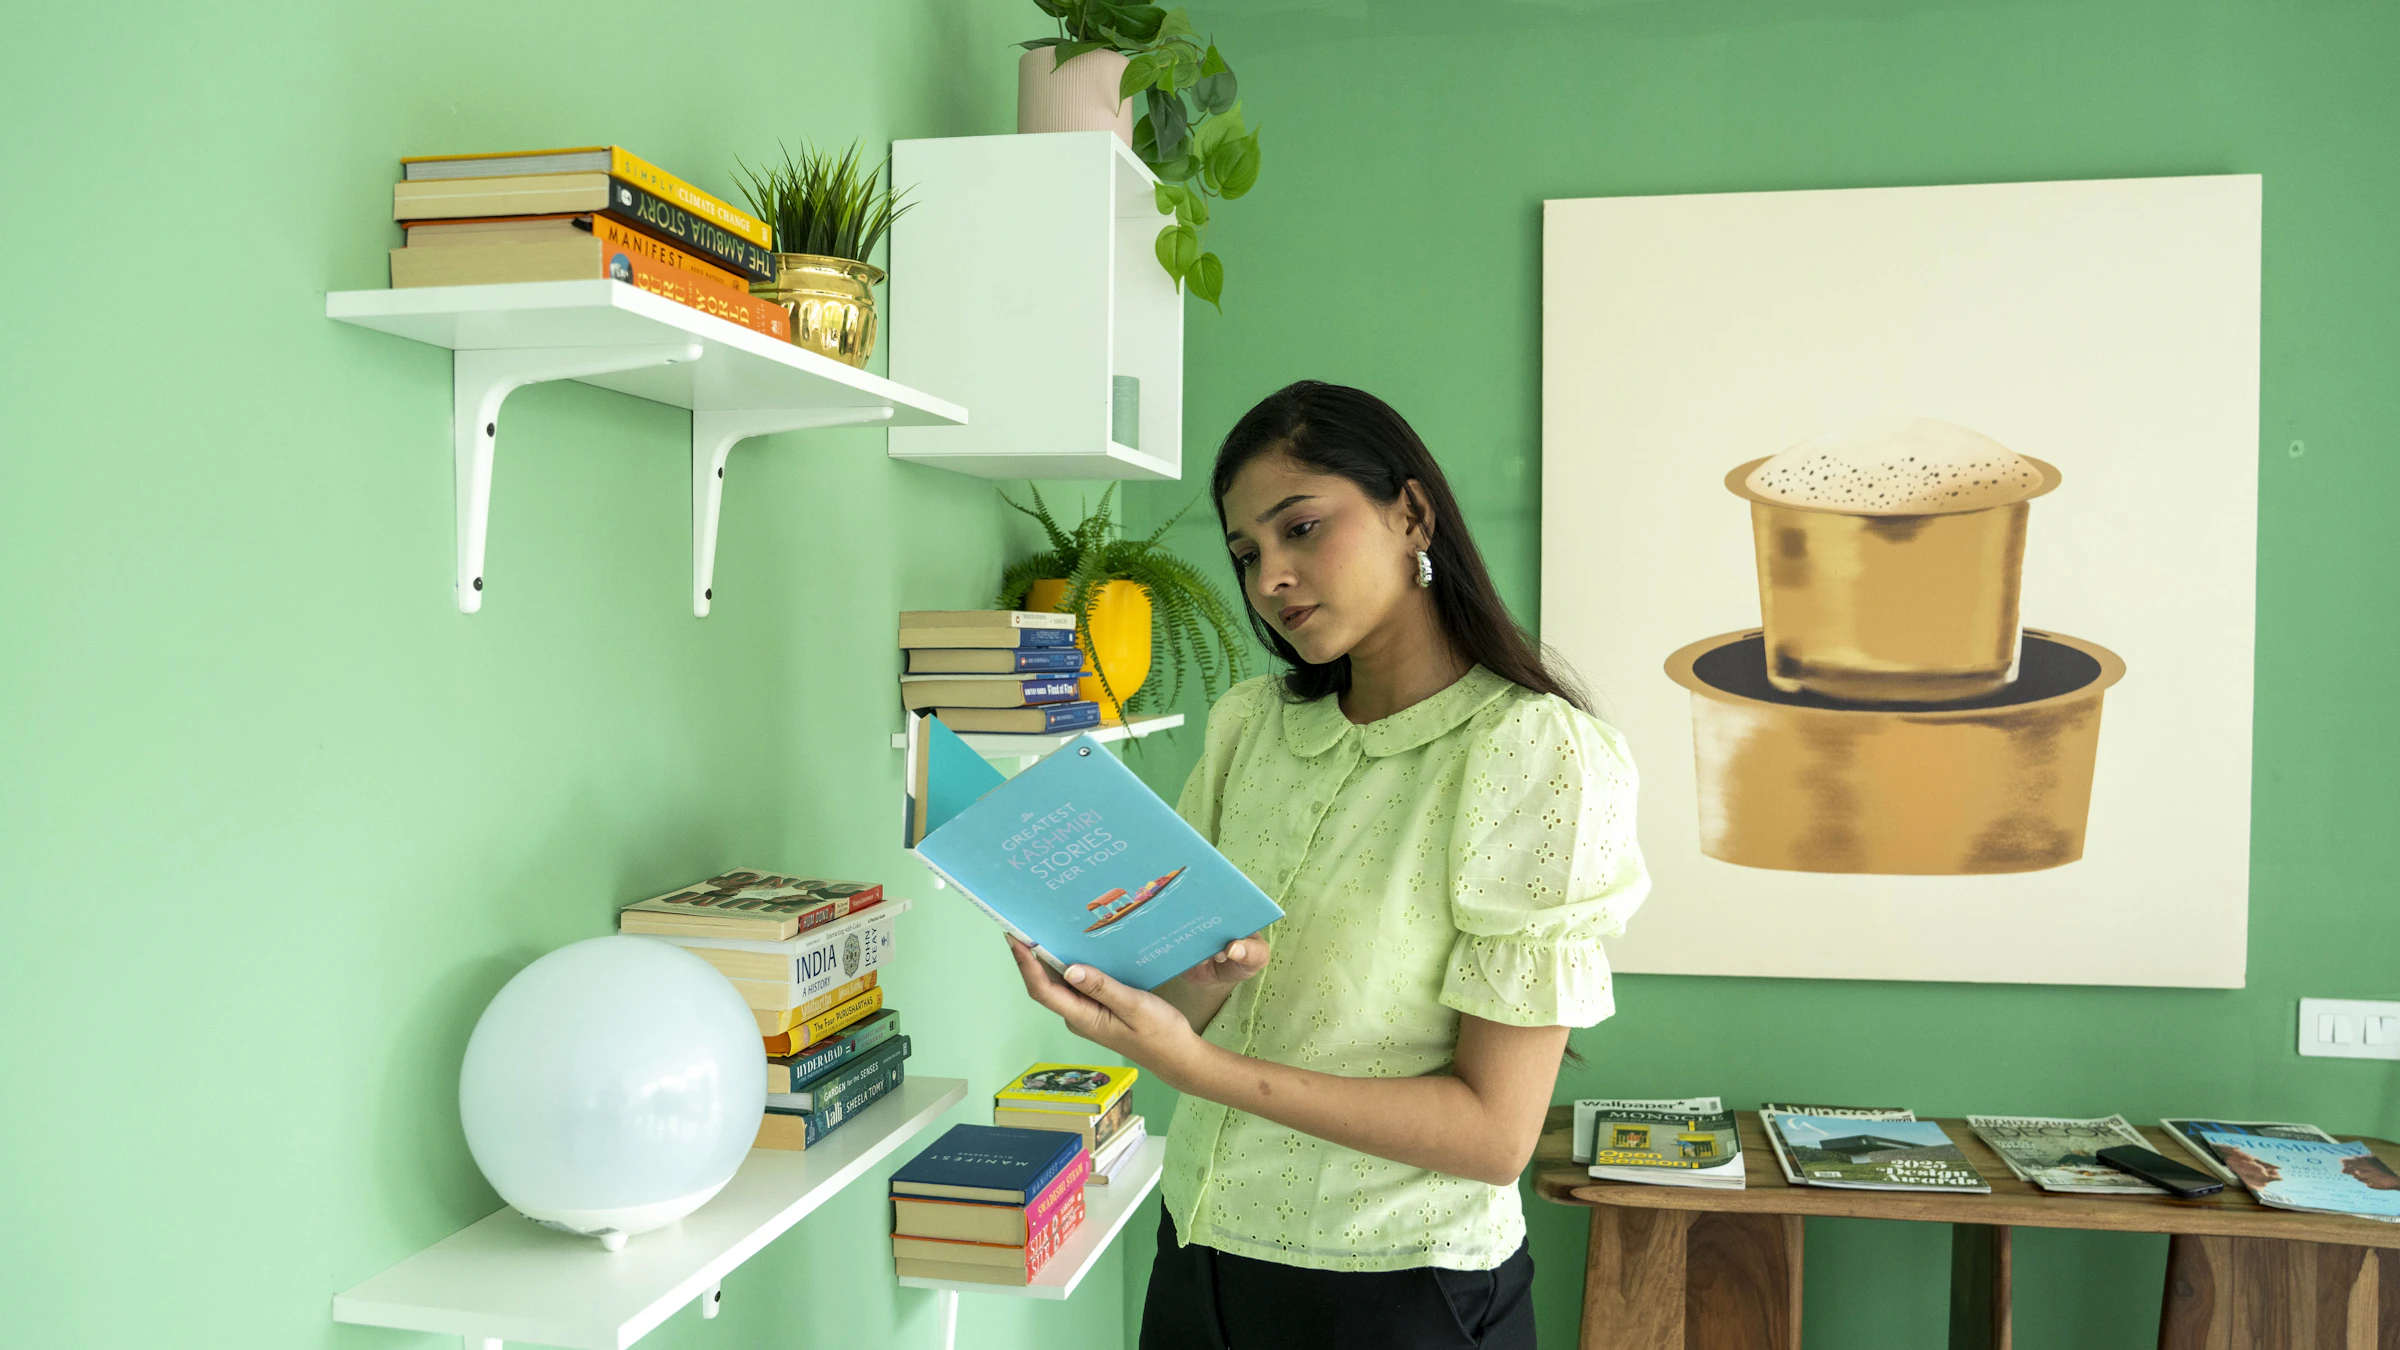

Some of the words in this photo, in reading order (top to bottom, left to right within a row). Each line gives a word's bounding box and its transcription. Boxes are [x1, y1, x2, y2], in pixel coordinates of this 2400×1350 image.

[625, 161, 674, 194] SIMPLY
[678, 187, 715, 216] CLIMATE
[717, 207, 751, 233] CHANGE
[637, 192, 686, 237] STORY
[608, 225, 684, 270] MANIFEST
[691, 217, 745, 264] AMBUJA
[749, 246, 772, 277] THE
[637, 271, 686, 303] GURU
[695, 287, 750, 325] WORLD
[1002, 802, 1076, 851] GREATEST
[1007, 808, 1103, 870] KASHMIRI
[1030, 827, 1113, 879] STORIES
[1045, 865, 1085, 890] EVER
[1084, 839, 1128, 866] TOLD
[803, 914, 815, 929] HUM
[815, 908, 829, 924] DONO
[826, 929, 845, 941] Interacting
[852, 921, 862, 931] Color
[1135, 943, 1175, 967] NEERJA
[1174, 916, 1222, 944] MATTOO
[796, 944, 837, 985] INDIA
[802, 988, 807, 998] A
[807, 976, 832, 995] HISTORY
[814, 1023, 824, 1032] The
[824, 1017, 835, 1026] Four
[835, 996, 873, 1020] PURUSHARTHAS
[796, 1044, 843, 1079] HYDERABAD
[823, 1082, 846, 1102] GARDEN
[860, 1061, 879, 1080] SENSES
[824, 1101, 843, 1129] Valli
[846, 1090, 868, 1113] SHEELA
[868, 1080, 884, 1098] TOMY
[1609, 1111, 1725, 1122] MONOCLE
[930, 1154, 1029, 1167] MANIFEST
[1599, 1149, 1663, 1159] Open
[1599, 1157, 1688, 1168] Season
[1890, 1159, 1948, 1170] 2025
[1032, 1162, 1058, 1195] MANIFEST
[1037, 1180, 1066, 1218] SWADESHI
[1065, 1162, 1083, 1188] STEAM
[1876, 1167, 1969, 1179] Design
[1883, 1174, 1978, 1186] Awards
[1030, 1223, 1049, 1256] SILK
[1031, 1245, 1051, 1280] SILK
